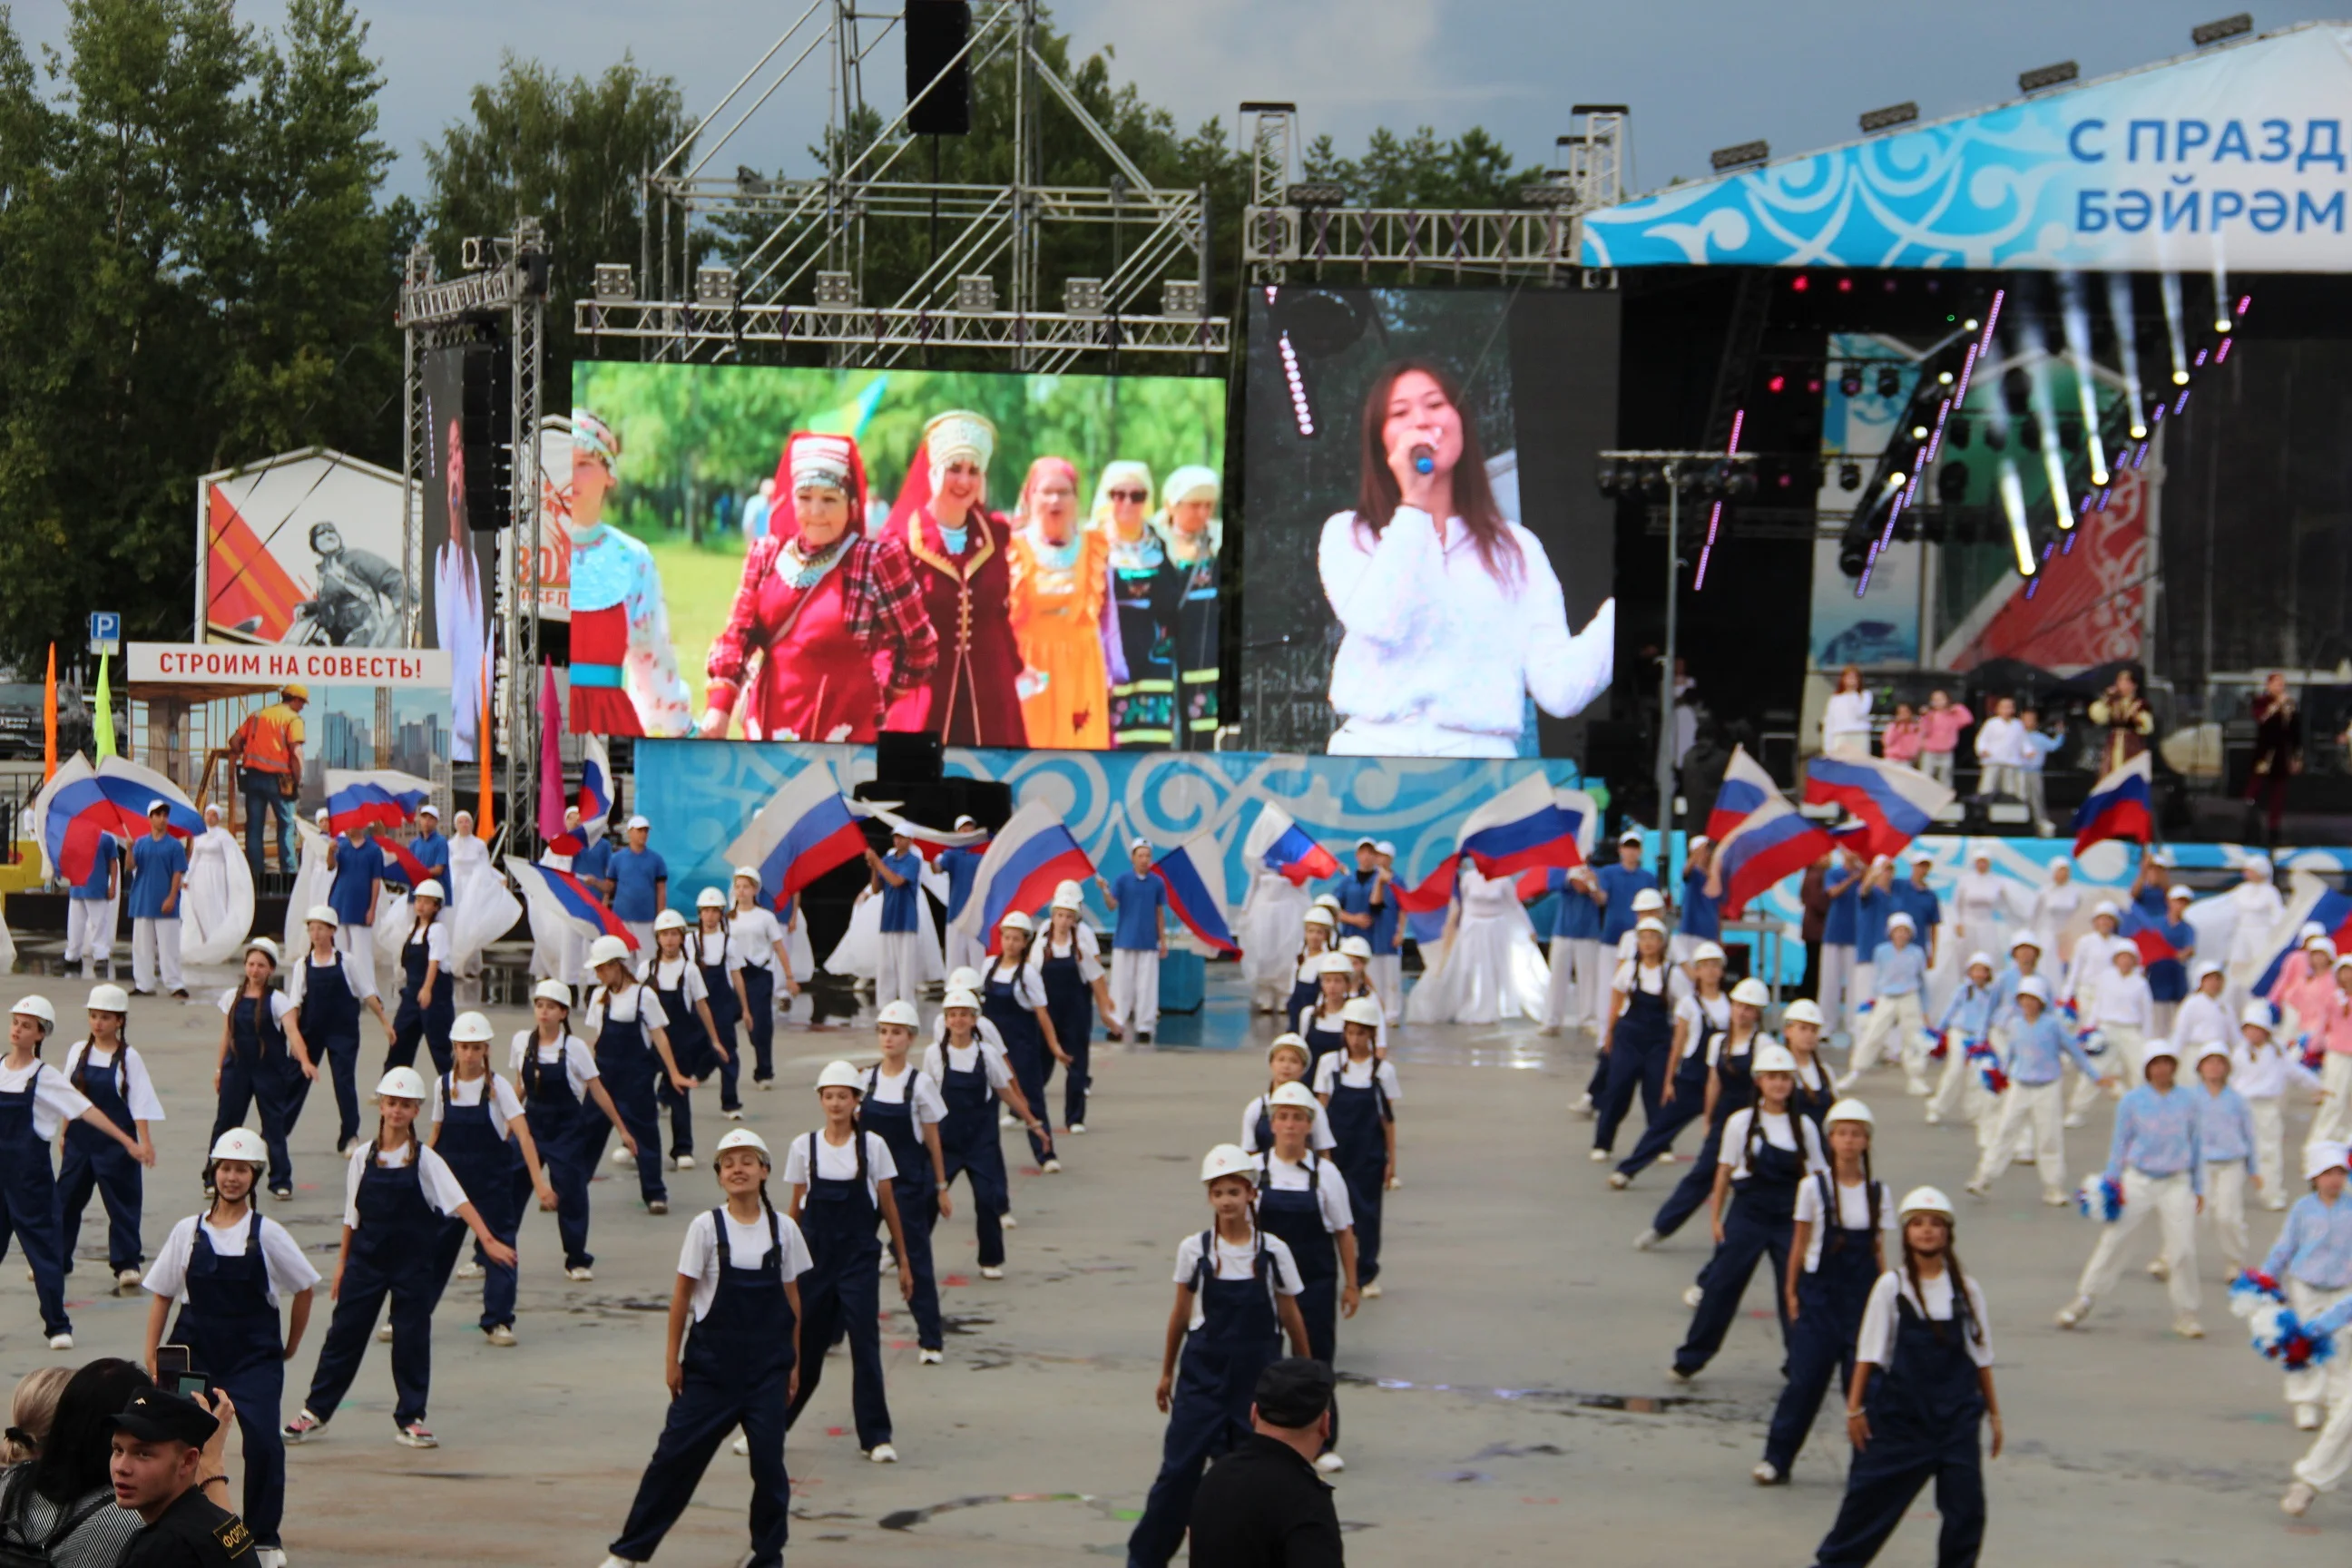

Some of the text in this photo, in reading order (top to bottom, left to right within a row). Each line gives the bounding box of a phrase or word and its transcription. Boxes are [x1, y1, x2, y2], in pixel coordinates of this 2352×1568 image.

[2068, 119, 2347, 173] С ПРАЗД
[2075, 173, 2347, 234] БӘЙРӘМ
[97, 615, 113, 638] P
[159, 652, 423, 680] СТРОИМ НА СОВЕСТЬ!
